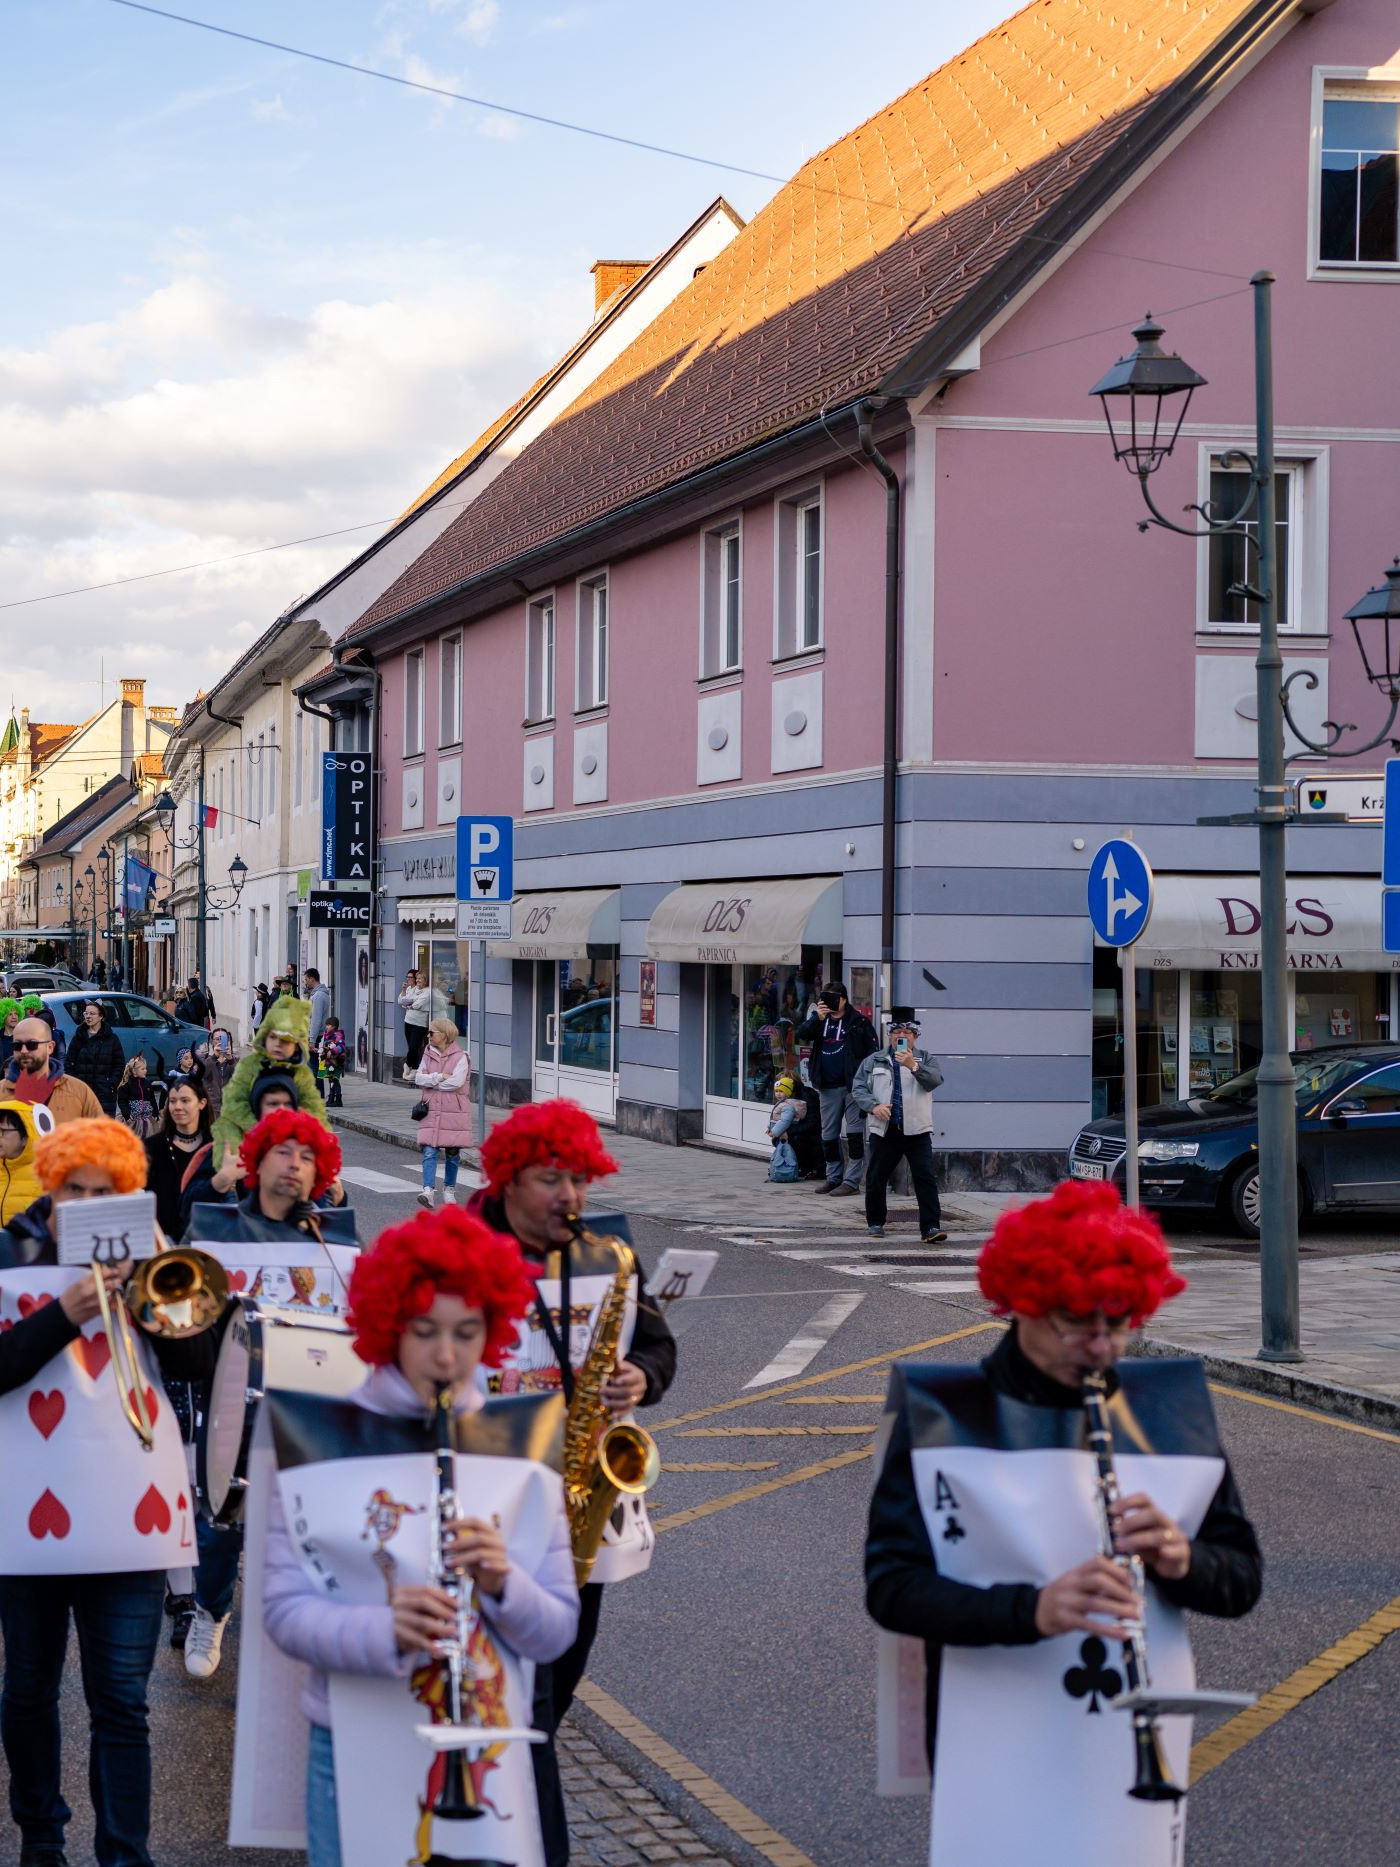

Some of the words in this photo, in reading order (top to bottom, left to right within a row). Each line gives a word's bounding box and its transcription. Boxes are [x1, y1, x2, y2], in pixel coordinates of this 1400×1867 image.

[350, 759, 366, 877] OPTIKA
[470, 823, 500, 865] P
[311, 900, 334, 909] optika
[697, 947, 737, 962] PAPIRNICA
[1219, 953, 1344, 969] KNJARNA
[934, 1468, 960, 1511] A
